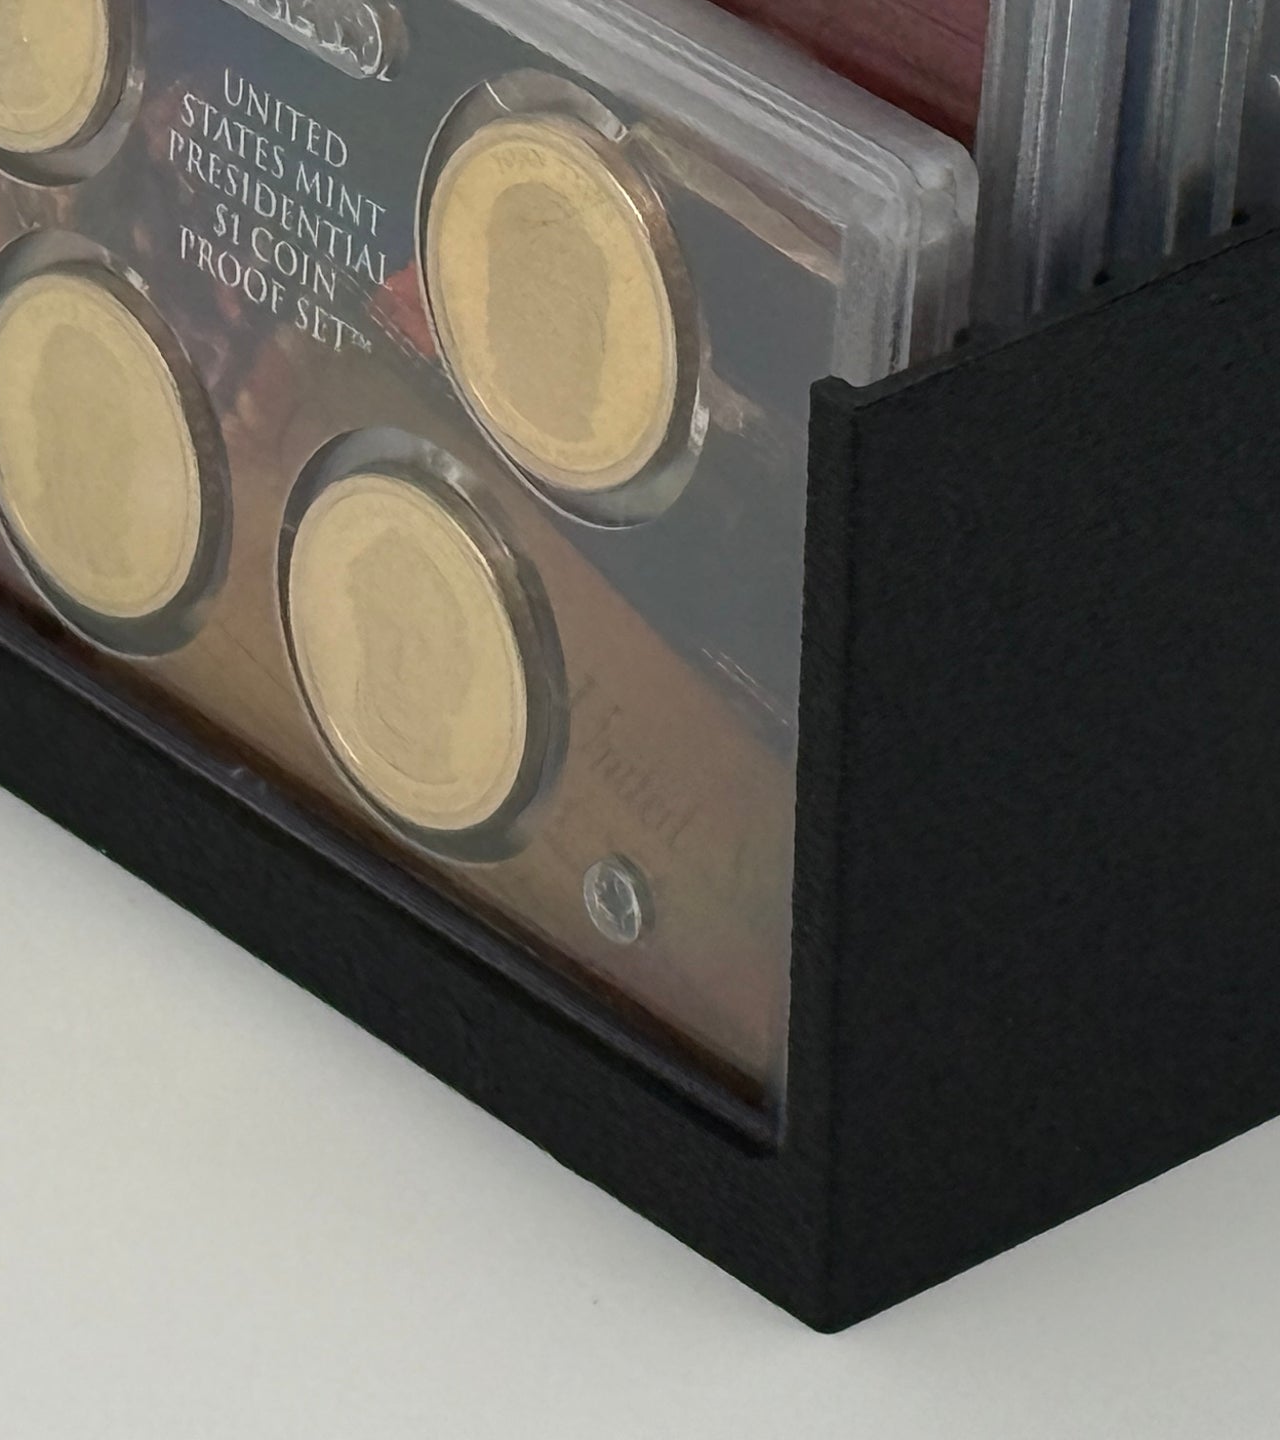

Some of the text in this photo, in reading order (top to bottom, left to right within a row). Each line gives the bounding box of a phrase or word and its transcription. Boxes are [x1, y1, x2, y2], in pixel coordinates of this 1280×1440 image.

[180, 92, 387, 238] STATES MINT
[223, 68, 348, 168] UNITED
[169, 129, 393, 291] PRESIDENTIAL
[214, 202, 337, 301] $1 COIN
[179, 224, 285, 315] PROOF
